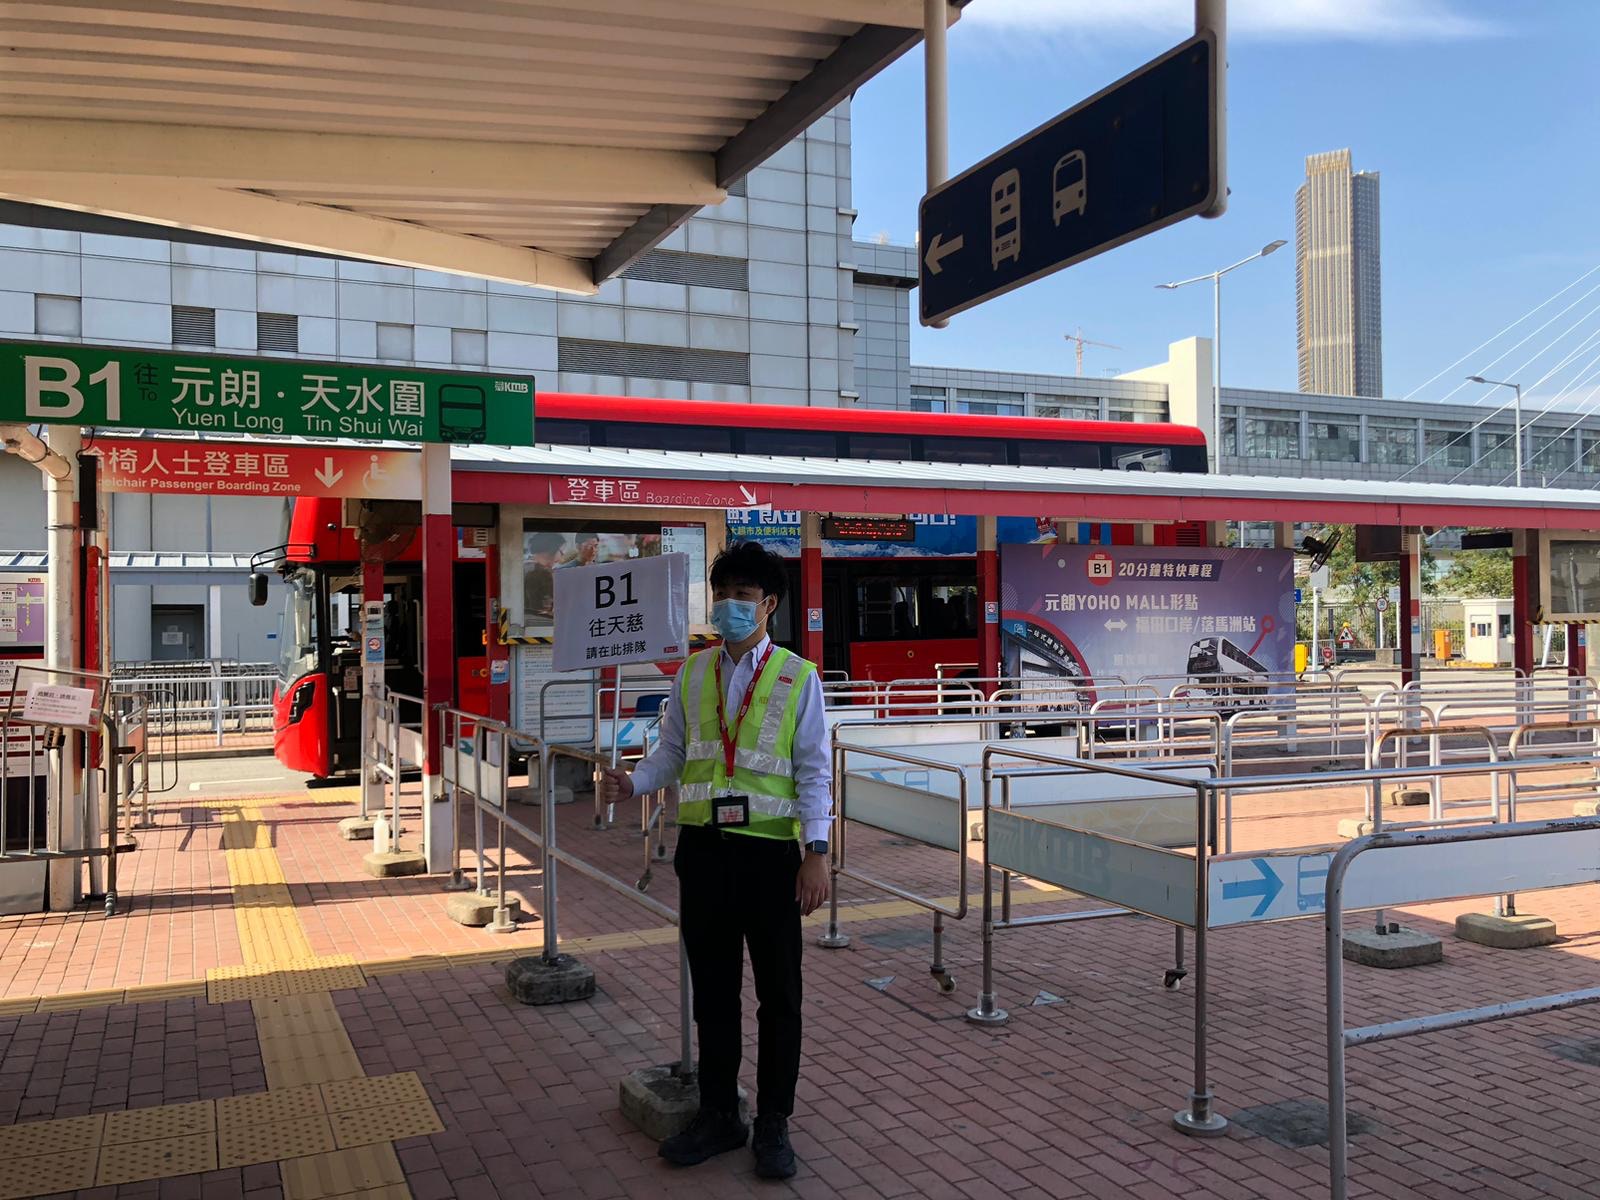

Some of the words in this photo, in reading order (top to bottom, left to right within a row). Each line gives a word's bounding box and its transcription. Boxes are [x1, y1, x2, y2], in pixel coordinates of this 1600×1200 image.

[134, 362, 160, 386] 往
[25, 355, 121, 421] B1
[139, 388, 157, 401] To
[172, 408, 226, 427] Yuen
[234, 411, 284, 434] Long
[303, 415, 332, 432] Tin
[340, 416, 381, 434] Shui
[388, 420, 423, 436] Wai
[151, 479, 213, 491] Passenger
[217, 481, 269, 492] Boarding
[272, 483, 301, 493] Zone
[567, 478, 641, 502] 登車區
[646, 492, 700, 506] Boarding
[704, 494, 735, 506] Zone
[662, 528, 674, 536] B1
[663, 544, 673, 553] B1
[1093, 563, 1107, 575] B1
[1118, 562, 1213, 578] 20分鐘特快車程
[595, 571, 639, 609] B1
[589, 613, 644, 638] 往天慈
[586, 640, 647, 660] 請在此排隊
